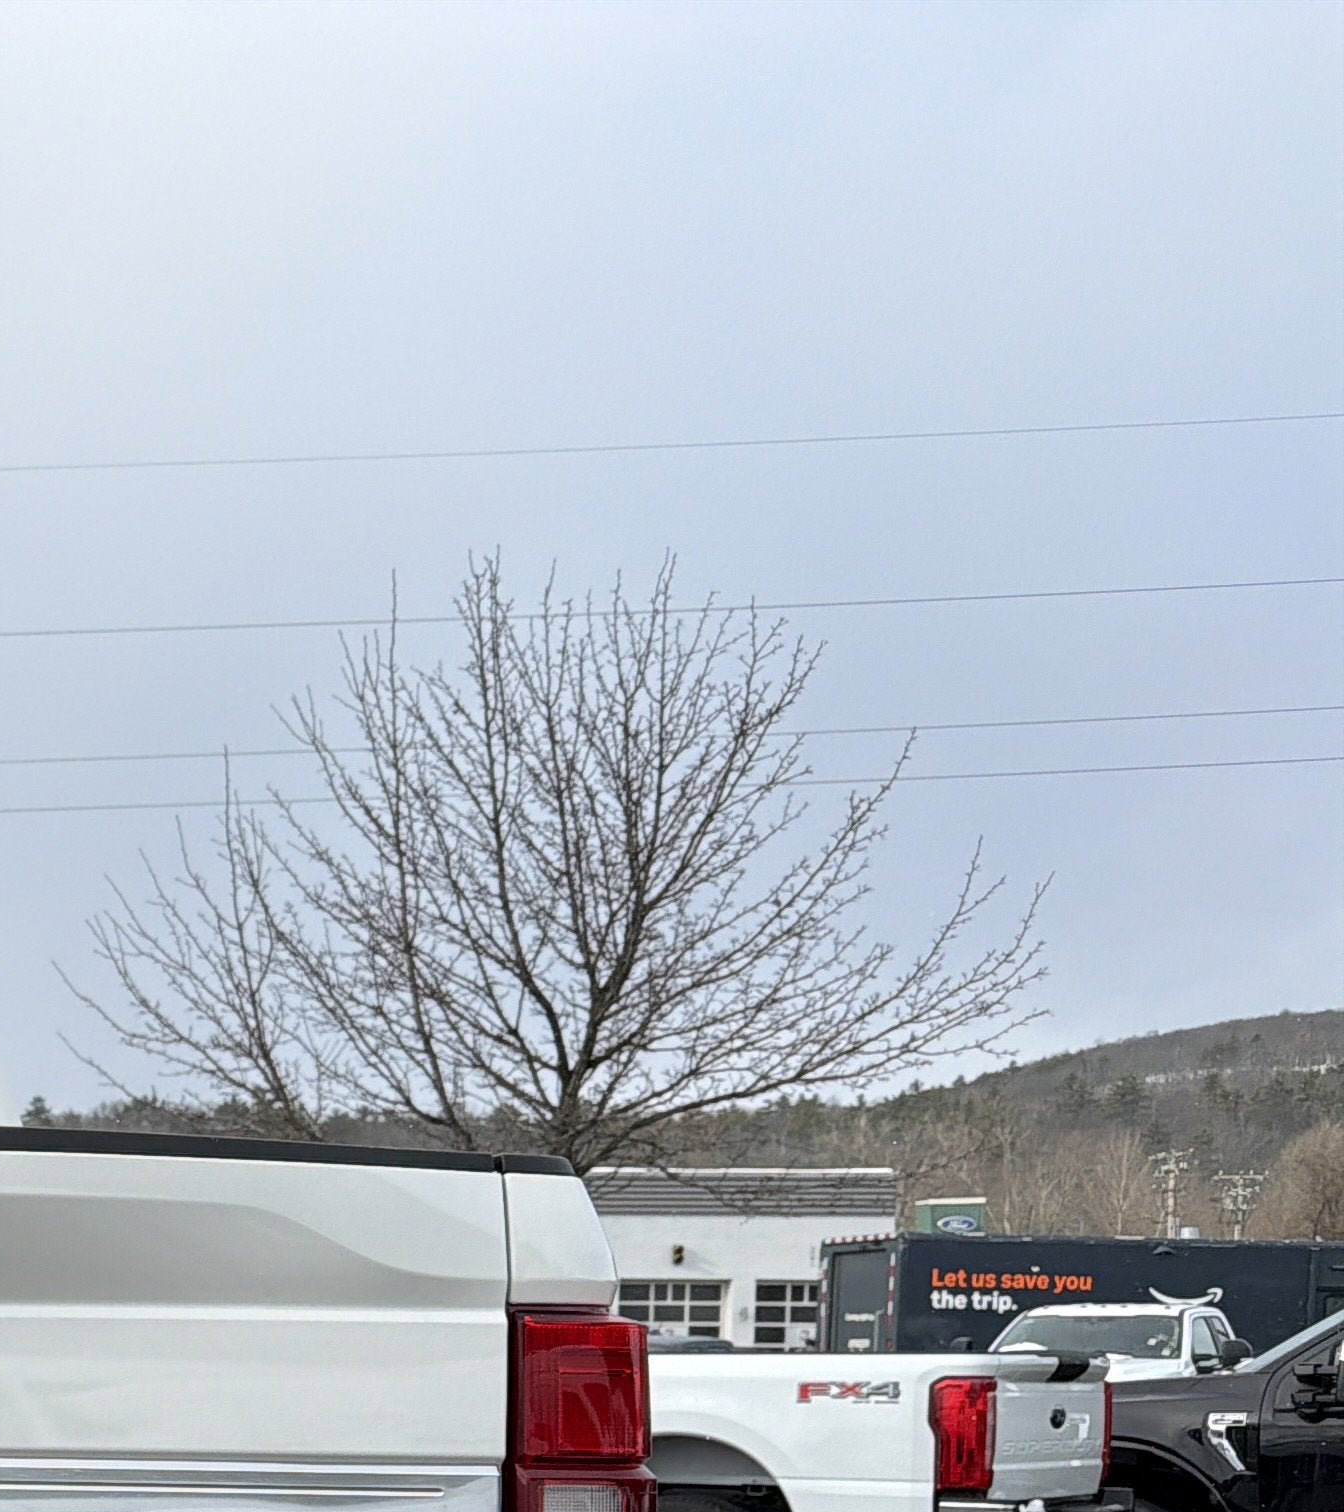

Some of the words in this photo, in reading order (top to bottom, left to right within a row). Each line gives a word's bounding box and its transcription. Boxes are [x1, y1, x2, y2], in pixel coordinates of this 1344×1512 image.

[931, 1268, 967, 1288] Let
[971, 1273, 997, 1288] us
[1000, 1273, 1050, 1290] save
[1053, 1275, 1093, 1294] you
[930, 1290, 968, 1310] the
[971, 1290, 1019, 1315] trip.
[796, 1380, 901, 1404] FX4
